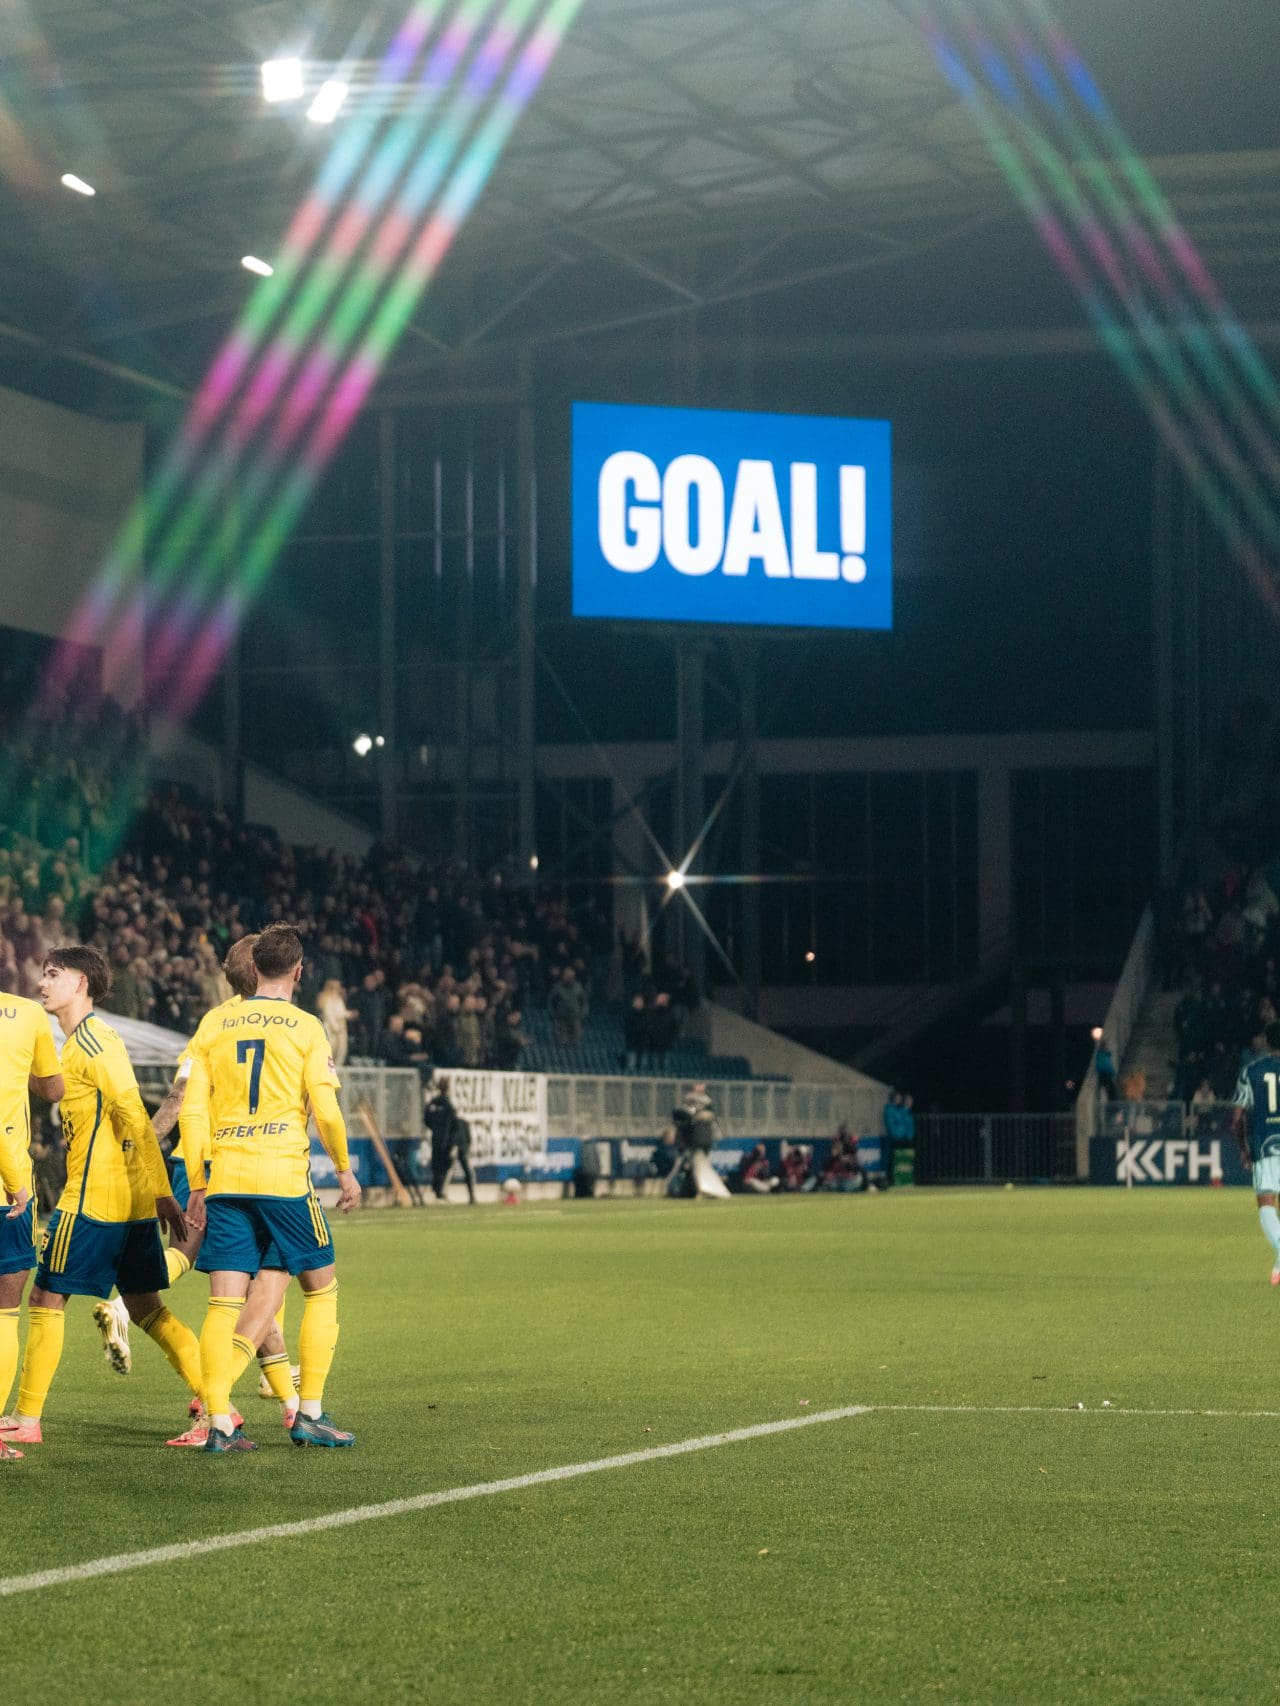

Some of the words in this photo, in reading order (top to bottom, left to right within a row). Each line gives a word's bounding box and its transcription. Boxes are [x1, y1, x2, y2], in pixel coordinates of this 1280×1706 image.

[598, 450, 867, 583] GOAL!
[222, 1012, 298, 1030] tanQyou
[236, 1038, 266, 1115] 7
[1263, 1072, 1280, 1114] 1
